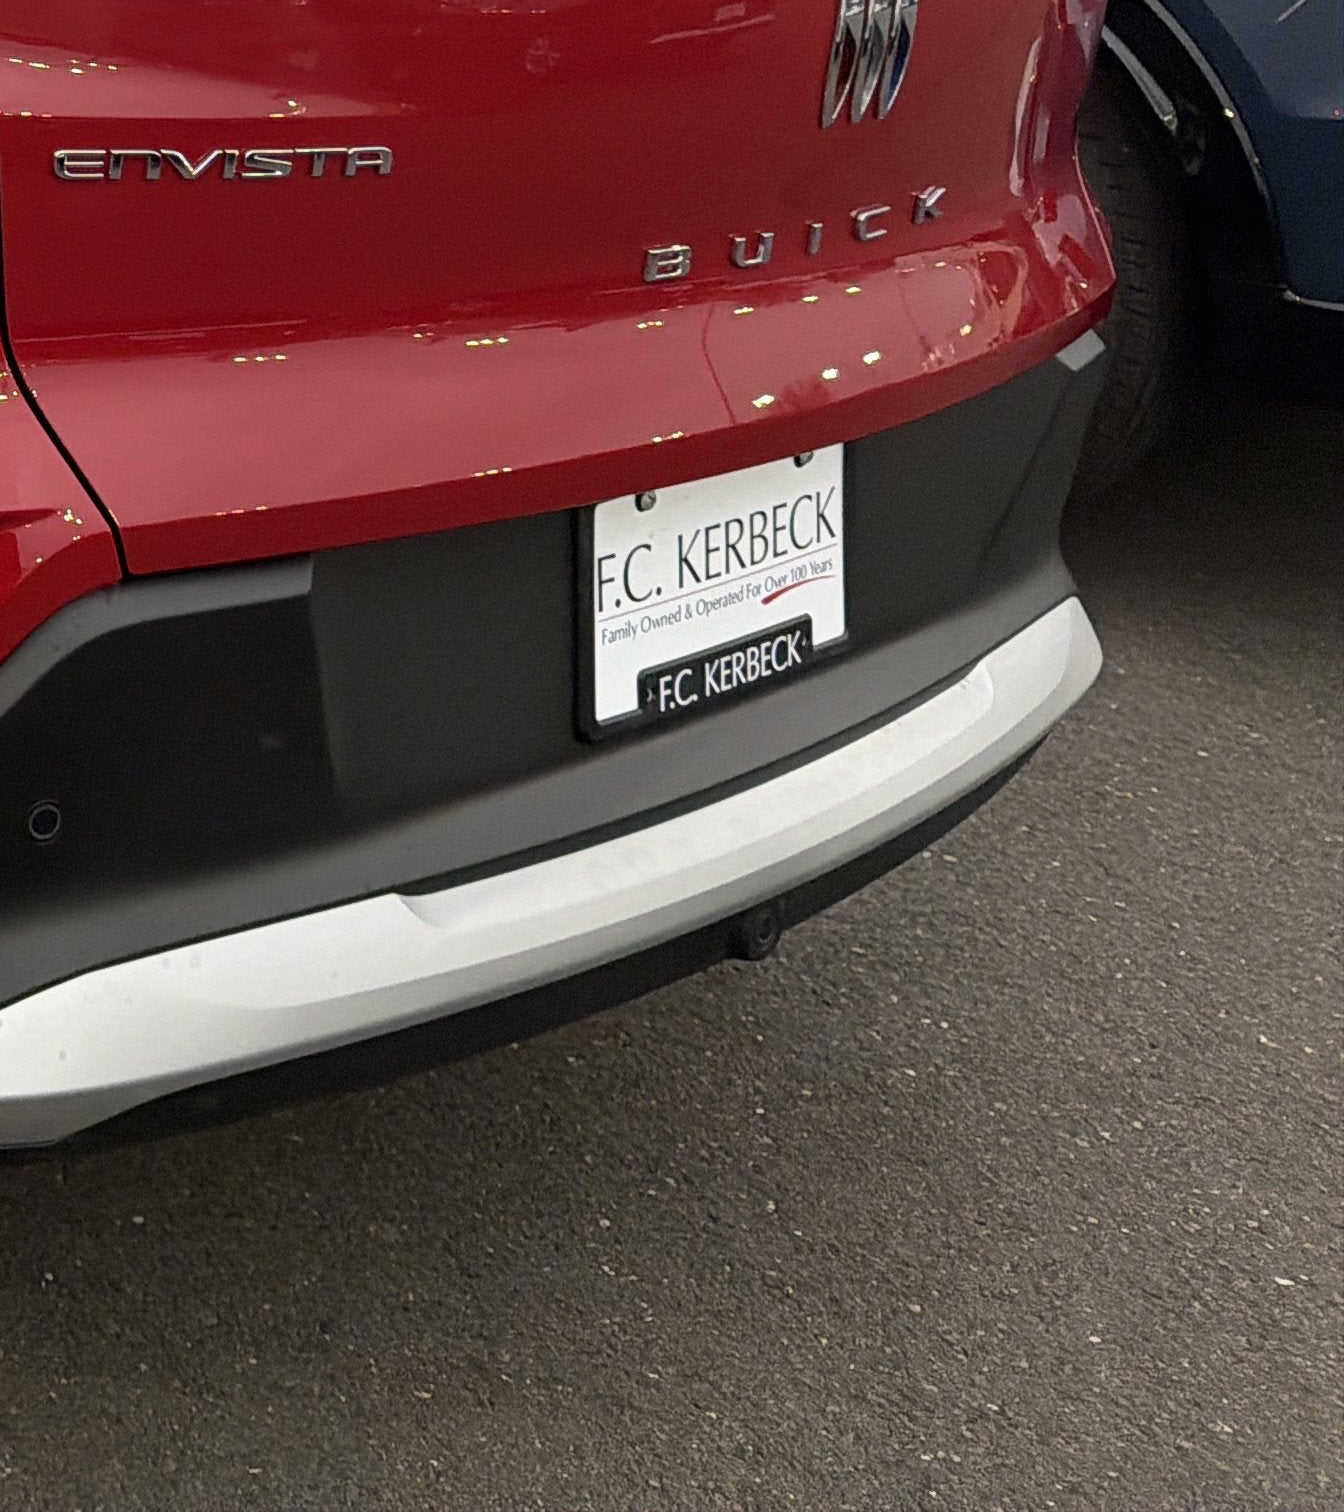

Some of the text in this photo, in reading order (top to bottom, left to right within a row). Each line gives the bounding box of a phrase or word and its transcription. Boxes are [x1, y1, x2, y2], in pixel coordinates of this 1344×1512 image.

[53, 146, 393, 181] ENVISTA
[643, 185, 947, 283] BUICK
[597, 486, 837, 613] F.C. KERBECK
[601, 558, 833, 646] Family Owned & Operated For Over 100 Years
[658, 629, 803, 713] F.C. KERBECK
